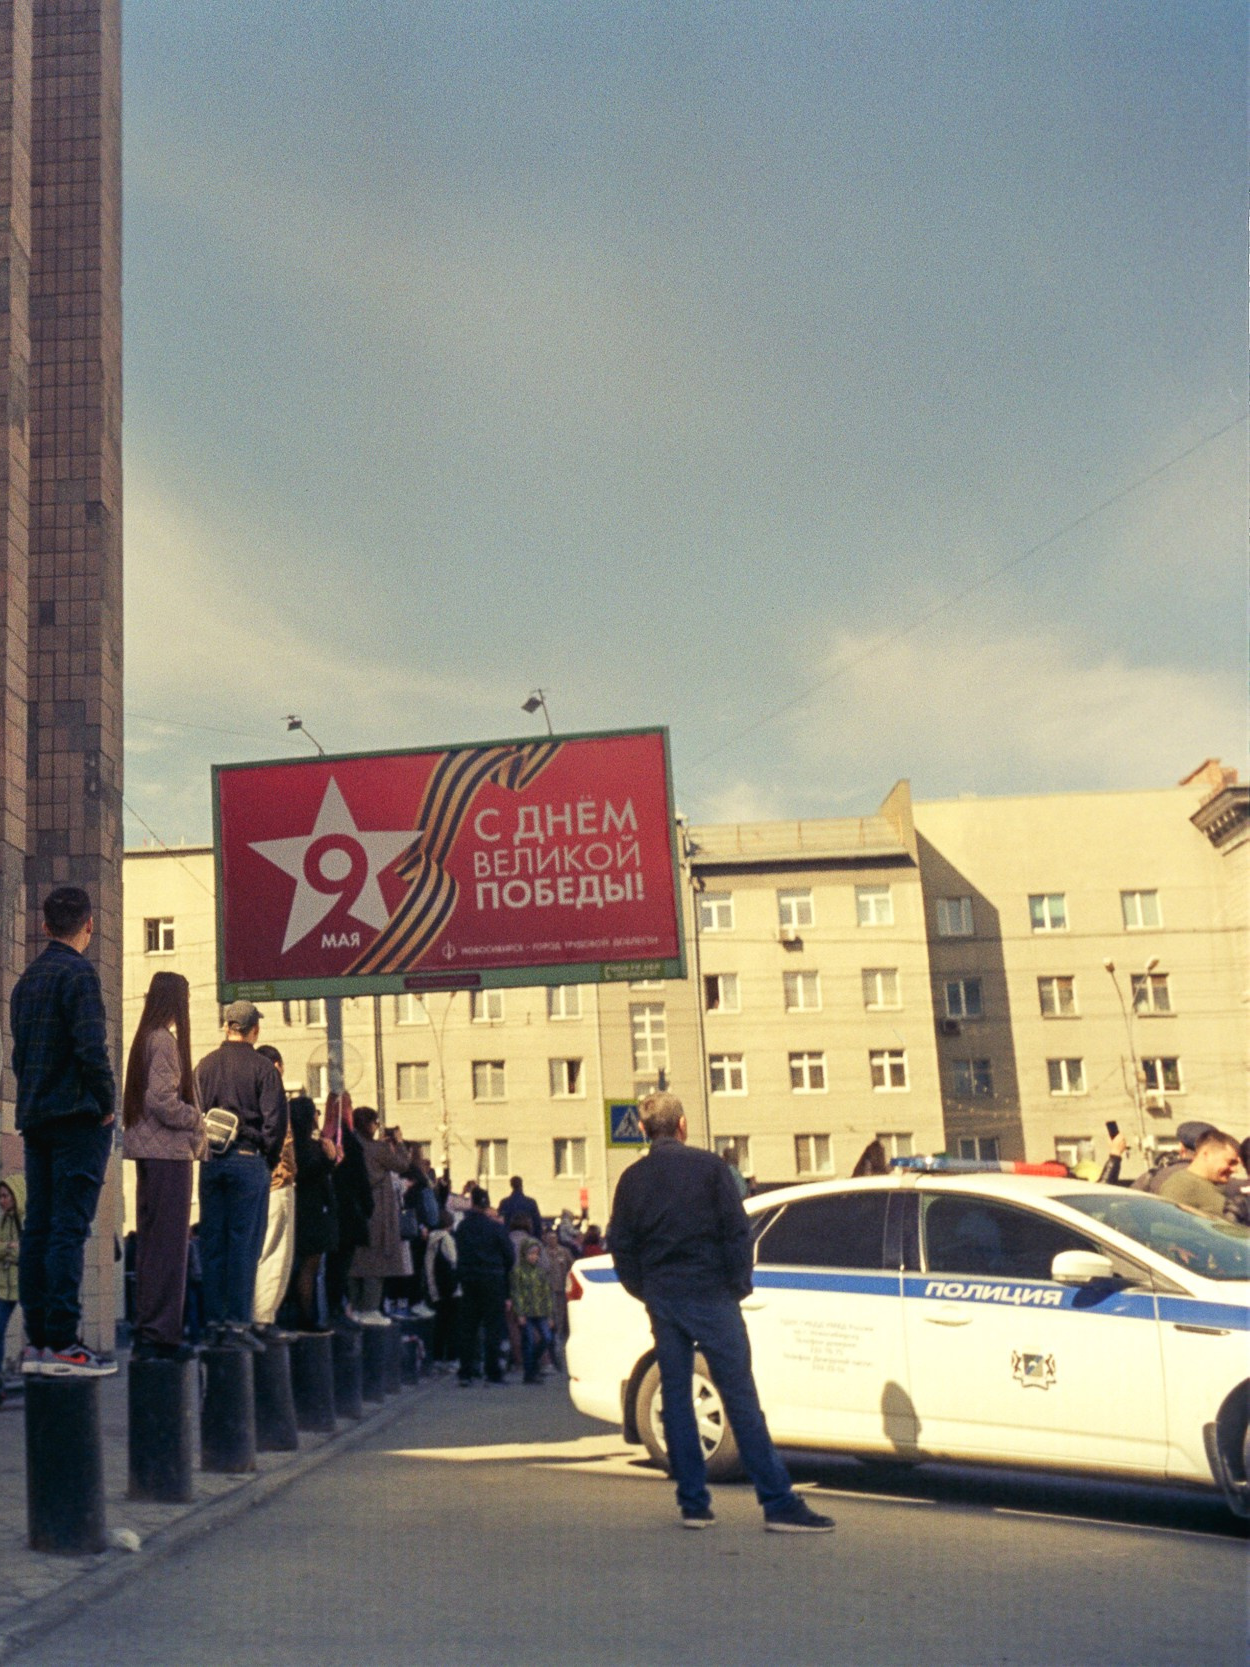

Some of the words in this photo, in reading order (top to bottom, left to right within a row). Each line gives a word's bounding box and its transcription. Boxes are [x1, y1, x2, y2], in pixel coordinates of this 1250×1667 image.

[474, 808, 501, 842] С
[513, 795, 638, 846] ДНЁМ
[473, 834, 641, 878] ВЕЛИКОЙ
[303, 833, 368, 922] 9
[476, 872, 645, 910] ПОБЕДЫ!
[321, 931, 361, 948] МАЯ
[924, 1281, 1063, 1306] ПОЛИЦИЯ
